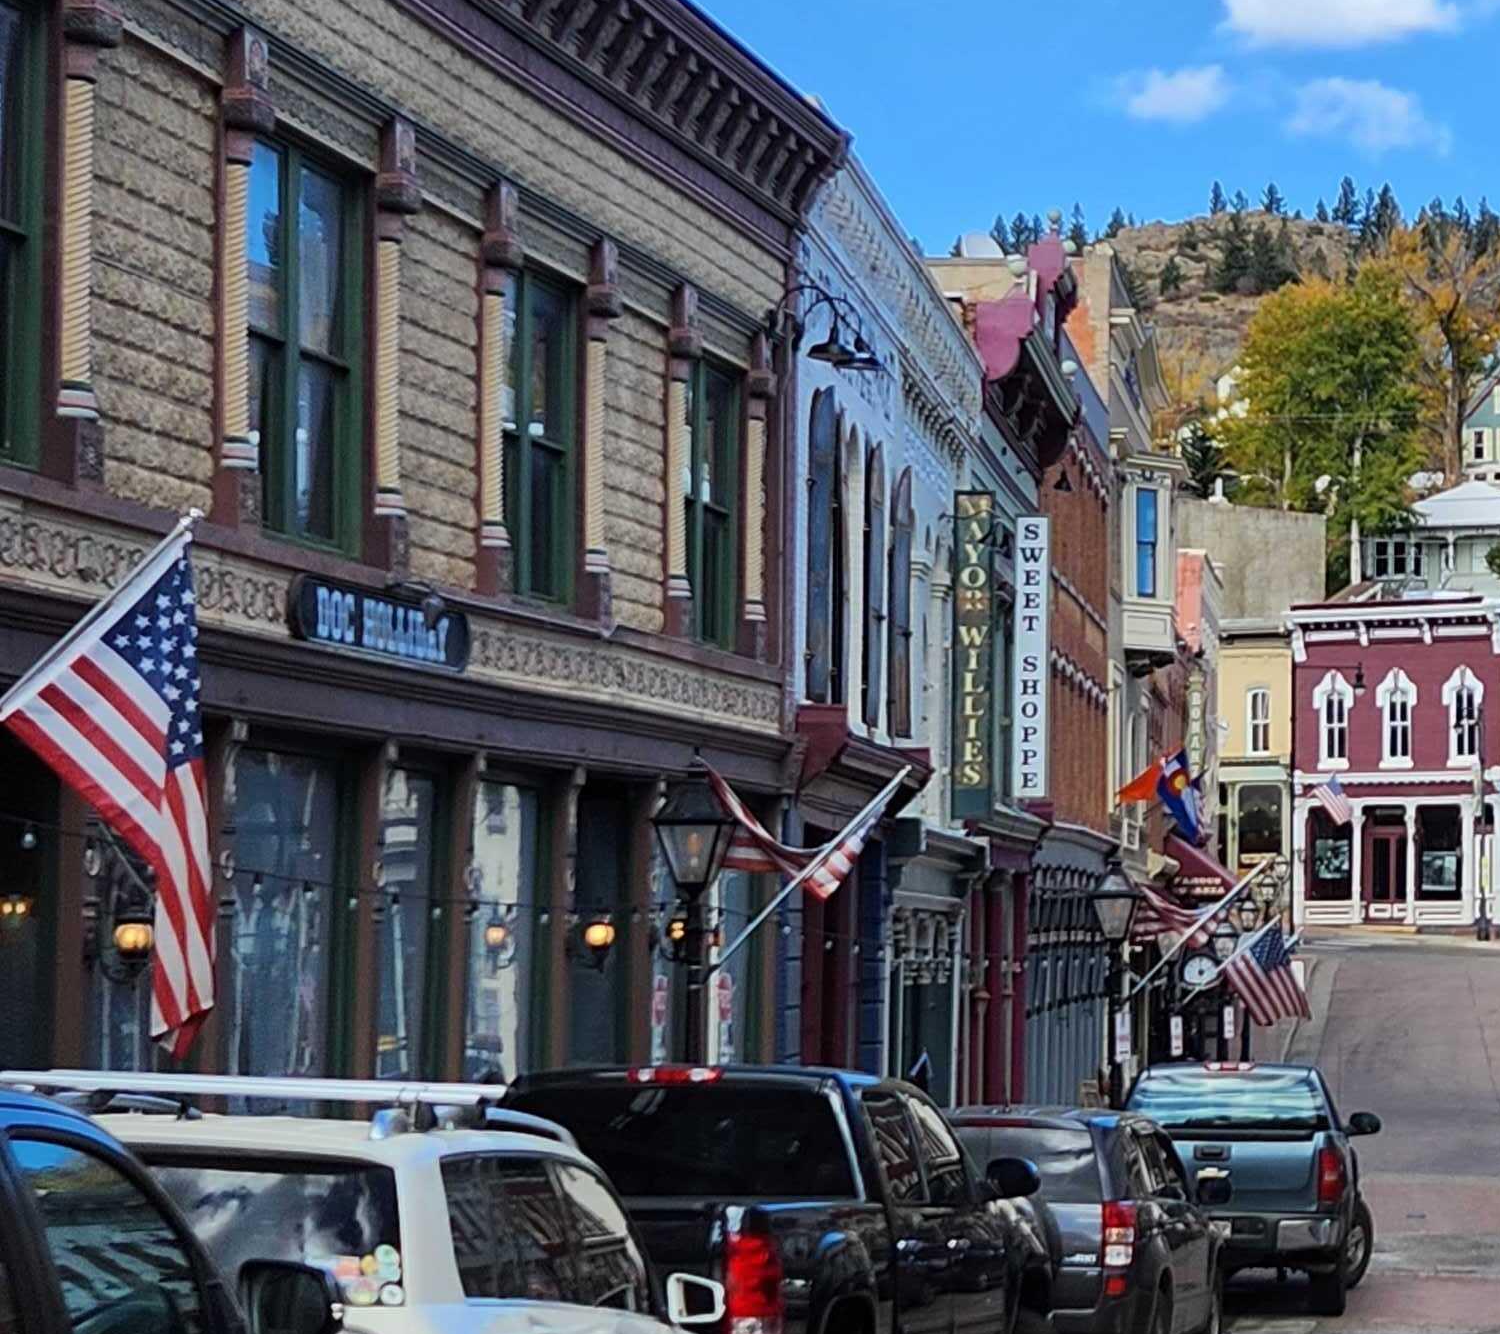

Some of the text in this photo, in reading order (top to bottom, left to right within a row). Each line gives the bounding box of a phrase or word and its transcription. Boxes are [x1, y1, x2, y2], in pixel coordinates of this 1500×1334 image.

[316, 586, 356, 644] DOC
[1019, 523, 1045, 789] SWEET SHOPPE
[958, 624, 988, 786] WILLIES
